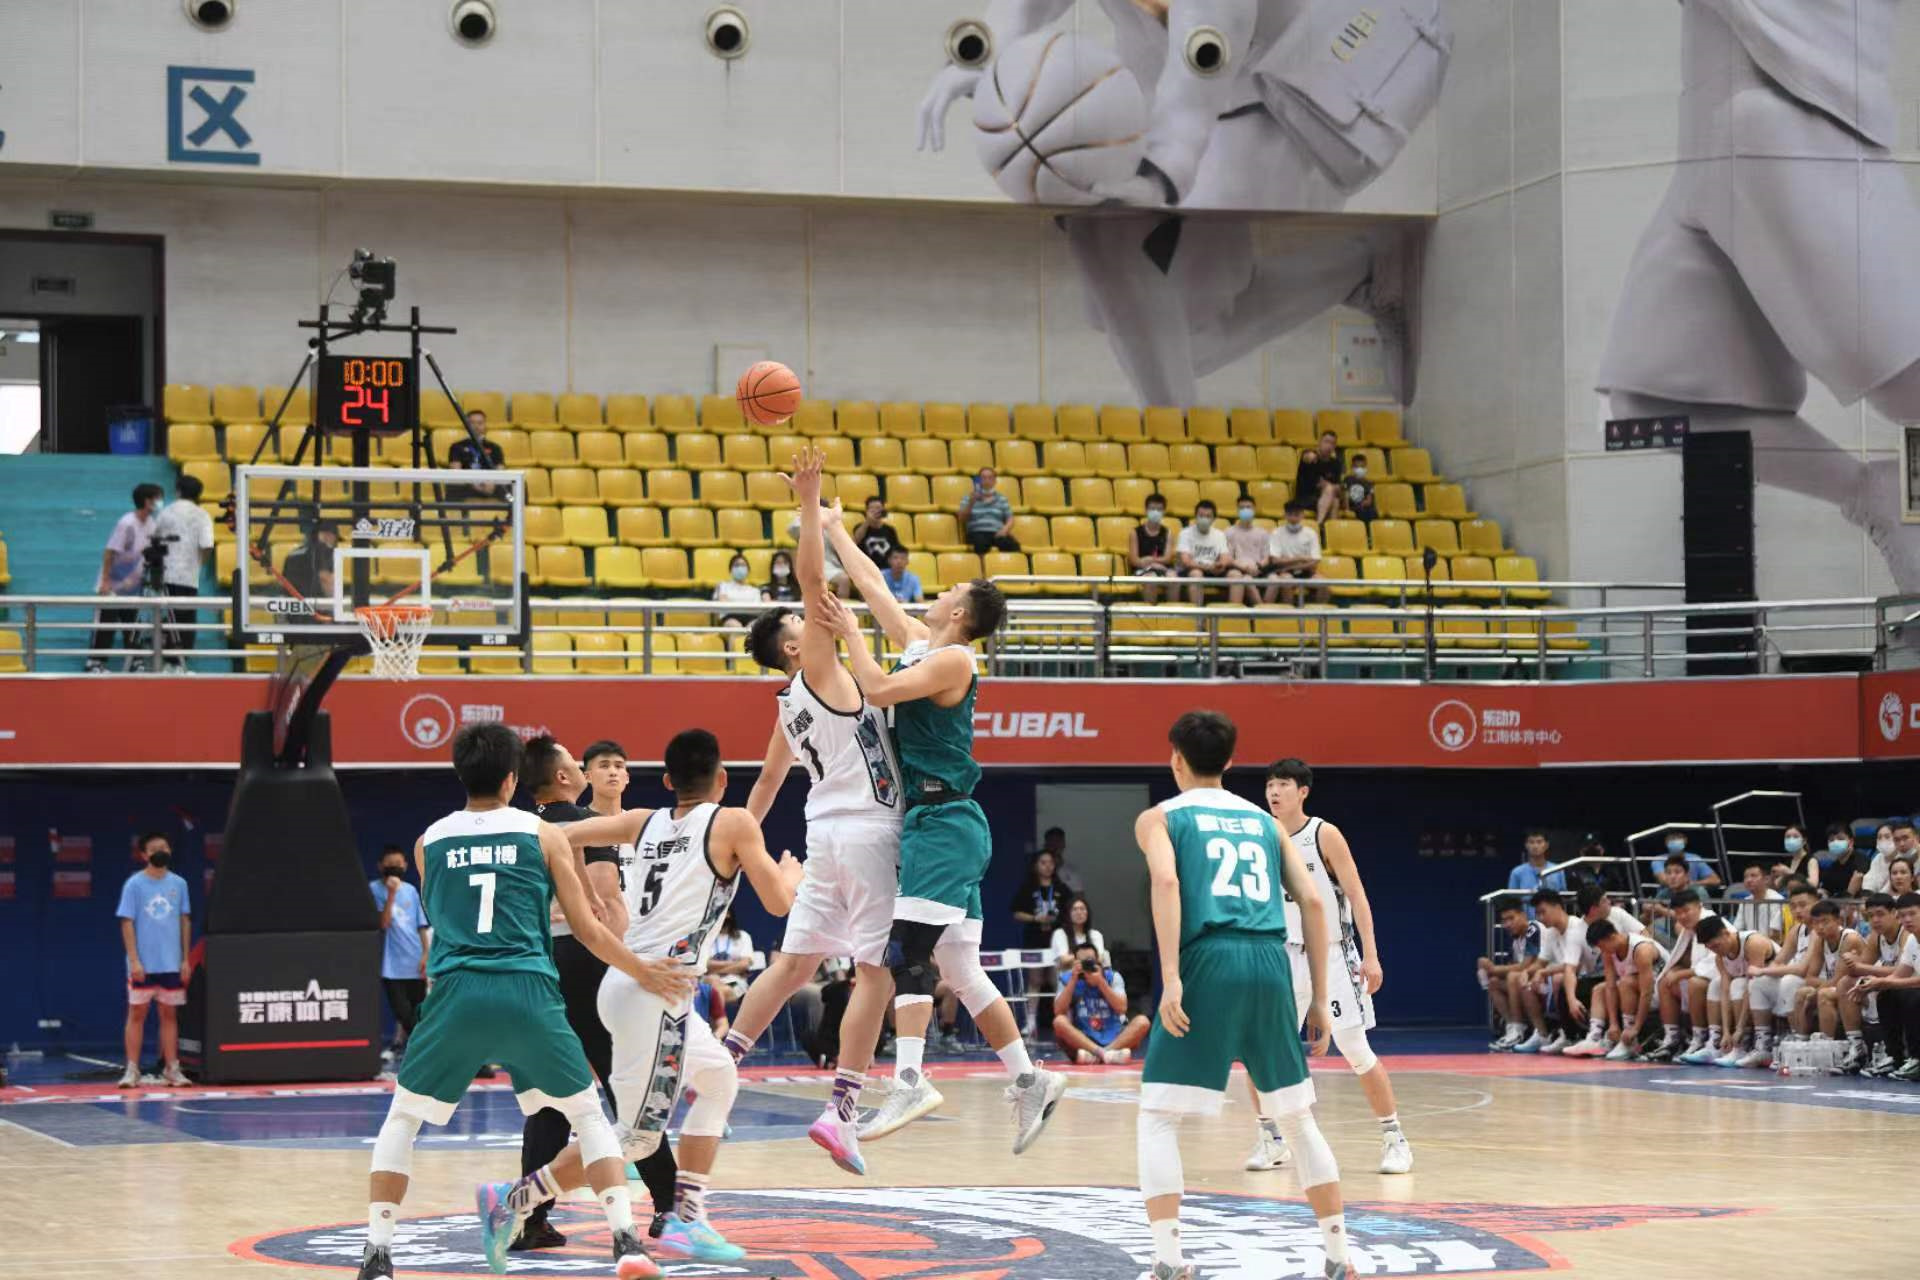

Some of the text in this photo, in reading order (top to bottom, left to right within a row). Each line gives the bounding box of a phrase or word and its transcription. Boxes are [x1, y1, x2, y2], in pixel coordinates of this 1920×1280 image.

[167, 65, 260, 166] 区
[344, 359, 404, 387] 10:00
[341, 385, 389, 424] 24
[801, 736, 824, 781] 1
[1206, 837, 1271, 902] 23
[639, 863, 669, 917] 5
[239, 979, 349, 1002] HONGKANG
[1331, 1000, 1341, 1018] 3
[239, 1000, 349, 1023] 宏康体育
